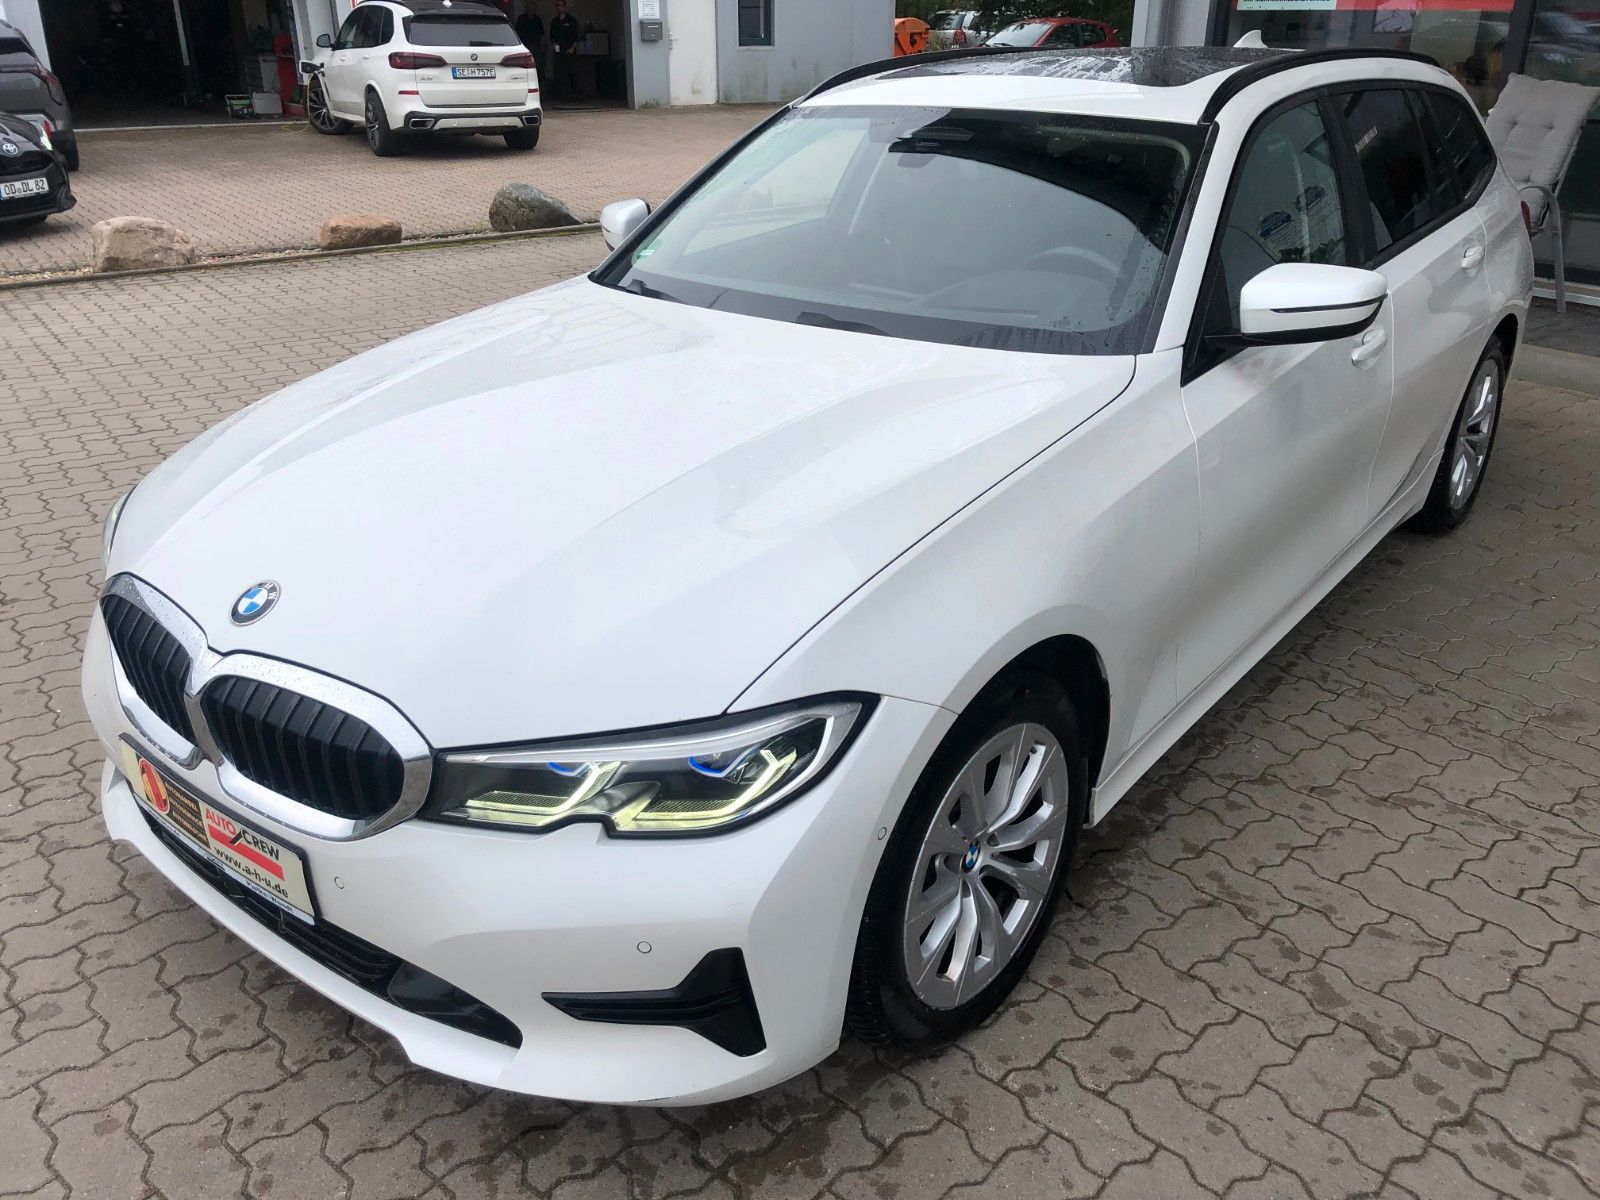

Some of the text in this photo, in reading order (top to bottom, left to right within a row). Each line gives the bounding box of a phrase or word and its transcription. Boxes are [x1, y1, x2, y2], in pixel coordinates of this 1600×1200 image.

[457, 68, 466, 77] SE
[4, 179, 46, 195] OD DL 82
[205, 806, 237, 837] AUTO
[241, 828, 280, 861] CREW
[213, 846, 289, 899] www.a-h-u.de
